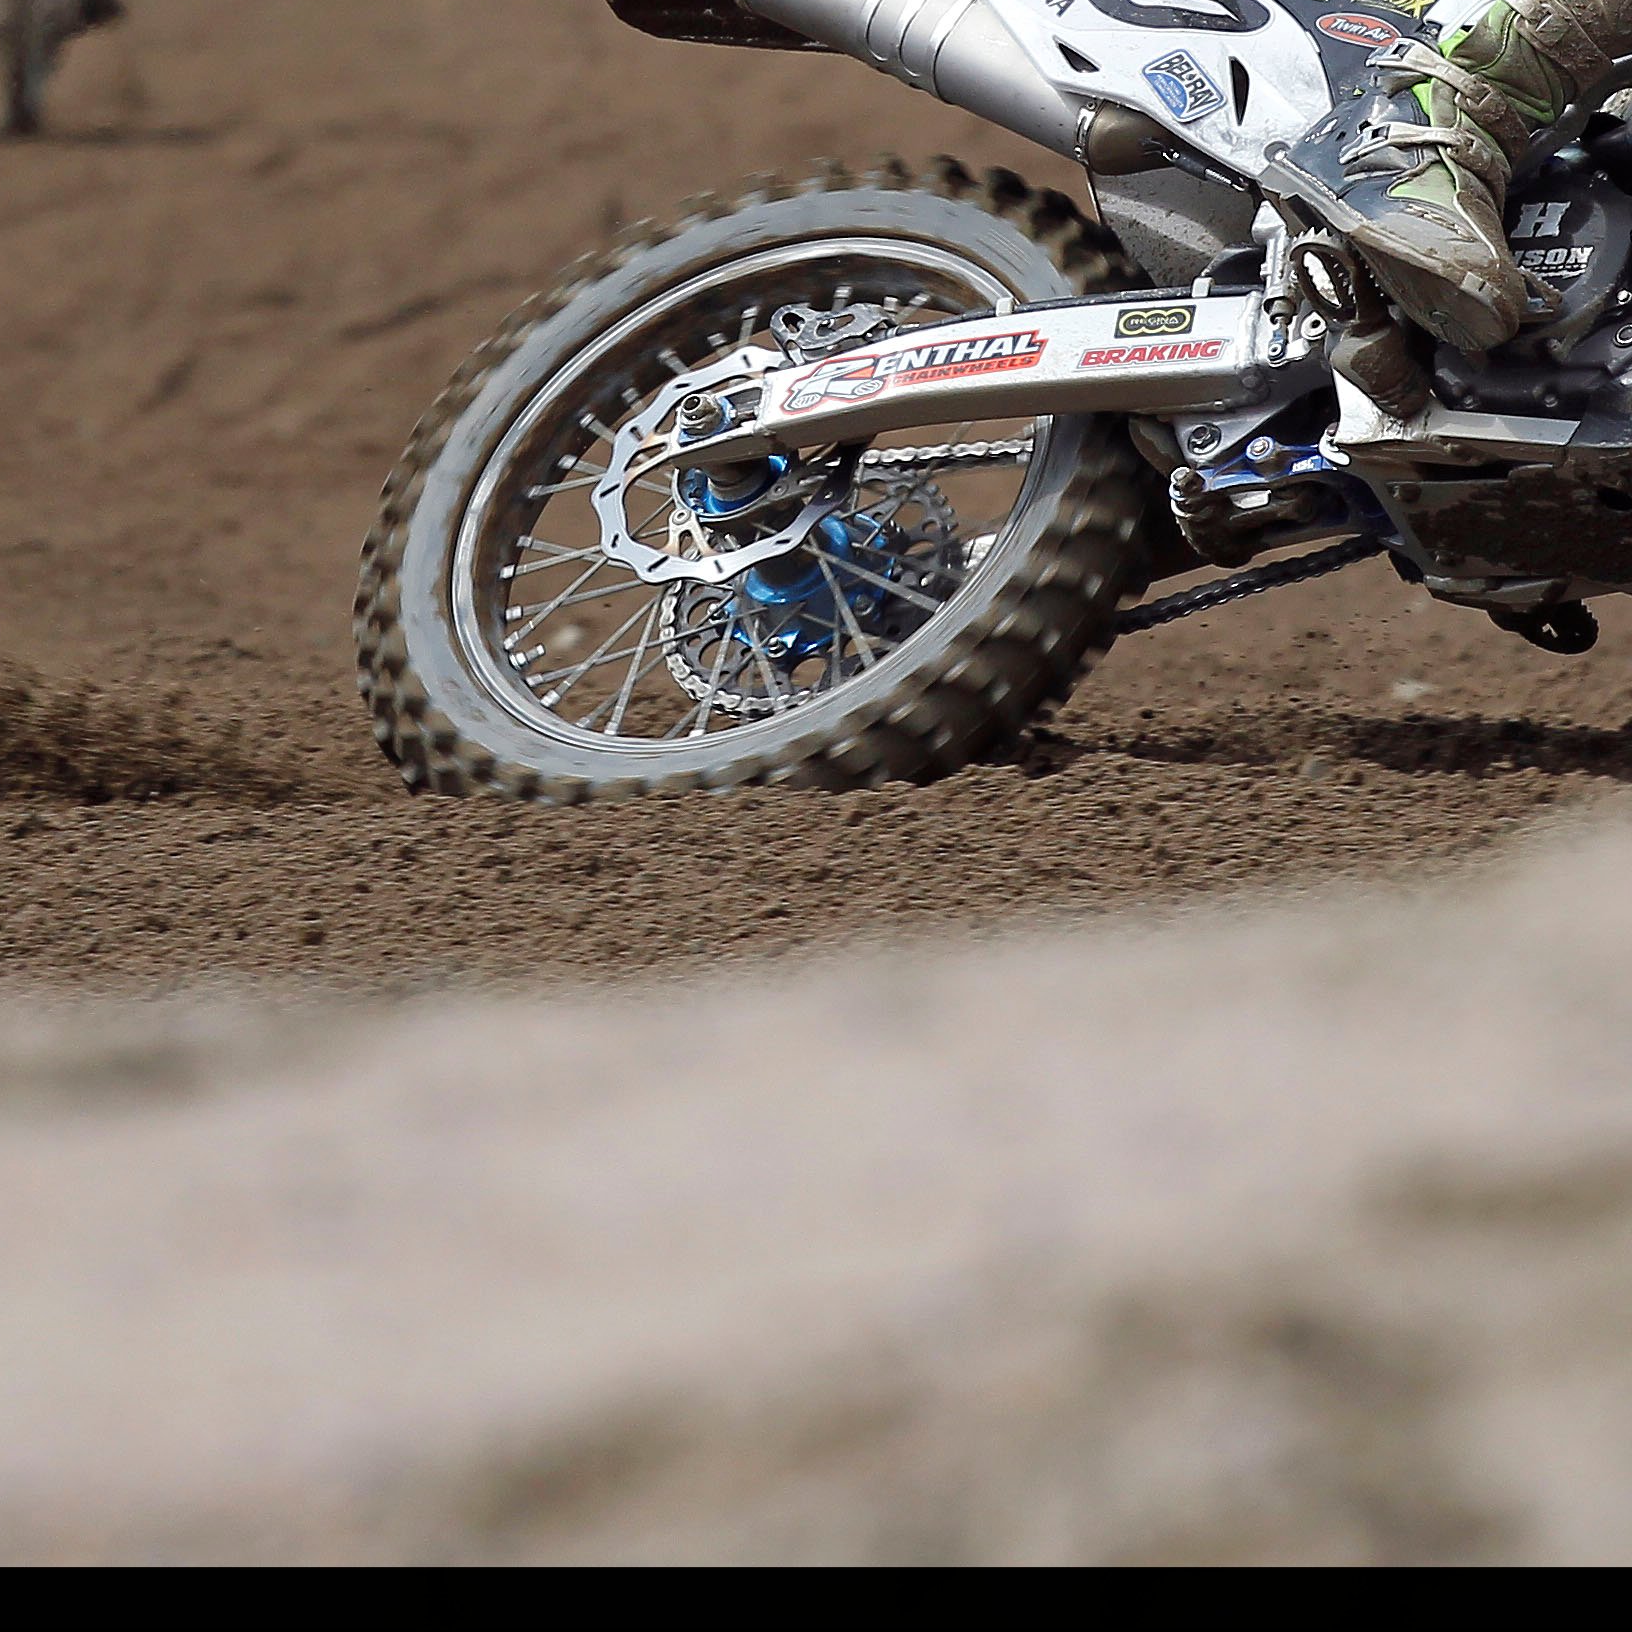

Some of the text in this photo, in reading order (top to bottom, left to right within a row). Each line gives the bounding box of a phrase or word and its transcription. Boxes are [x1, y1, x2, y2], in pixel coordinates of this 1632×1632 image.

[1330, 18, 1393, 42] Twin Air
[1080, 339, 1225, 368] BRAKING
[783, 332, 1042, 412] RENTHAL
[893, 356, 1036, 387] CHAINWHEELS
